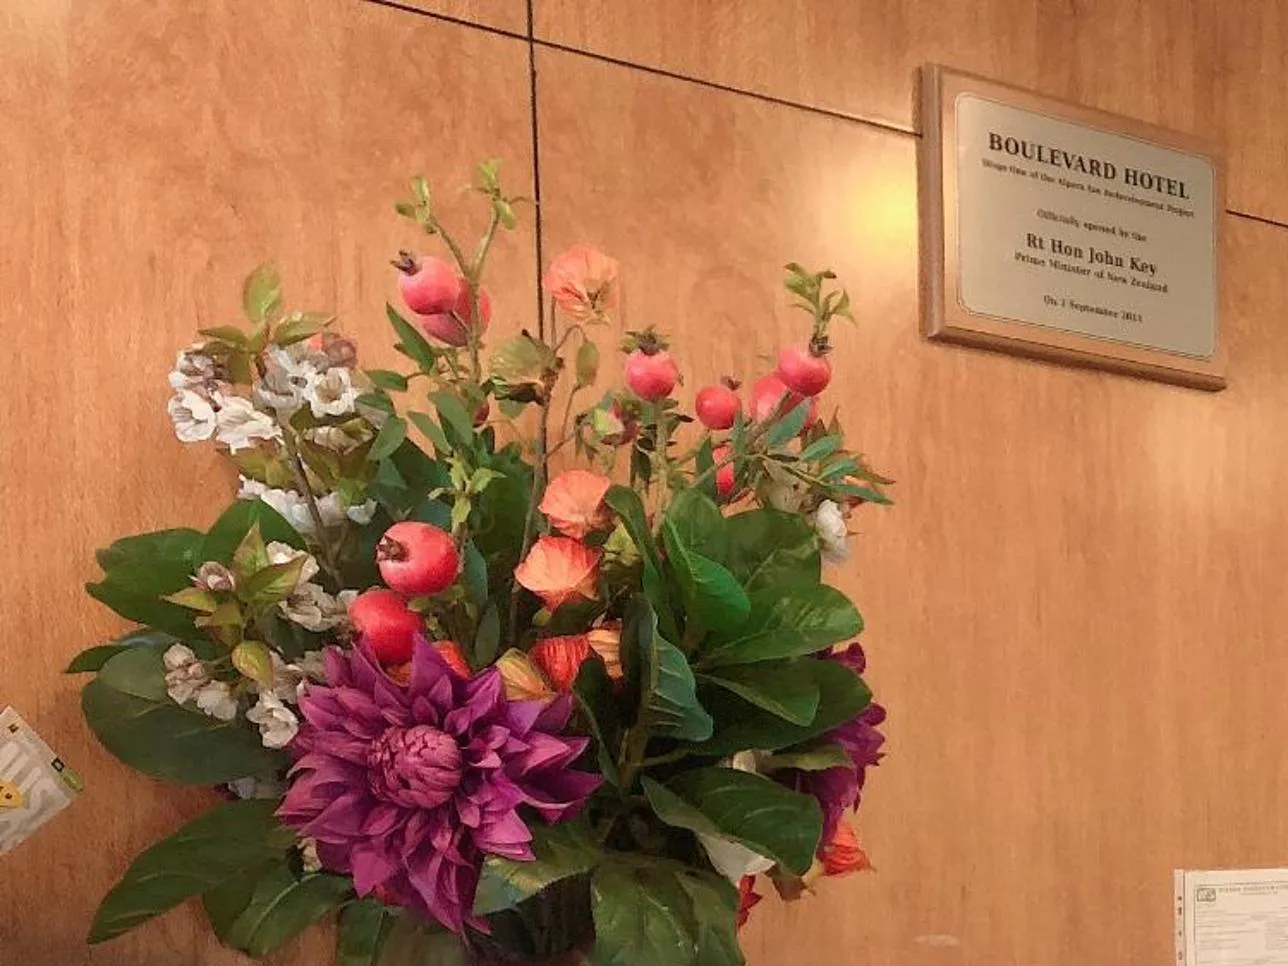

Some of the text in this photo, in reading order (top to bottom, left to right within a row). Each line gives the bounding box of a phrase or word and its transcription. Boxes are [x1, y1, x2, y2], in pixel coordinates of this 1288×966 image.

[989, 132, 1190, 199] BOULEVARD HOTEL
[1084, 221, 1116, 236] opened
[1014, 250, 1168, 293] Prime Minister of New Zealand
[1026, 233, 1157, 277] Rt Hon John Key
[1069, 298, 1118, 318] September
